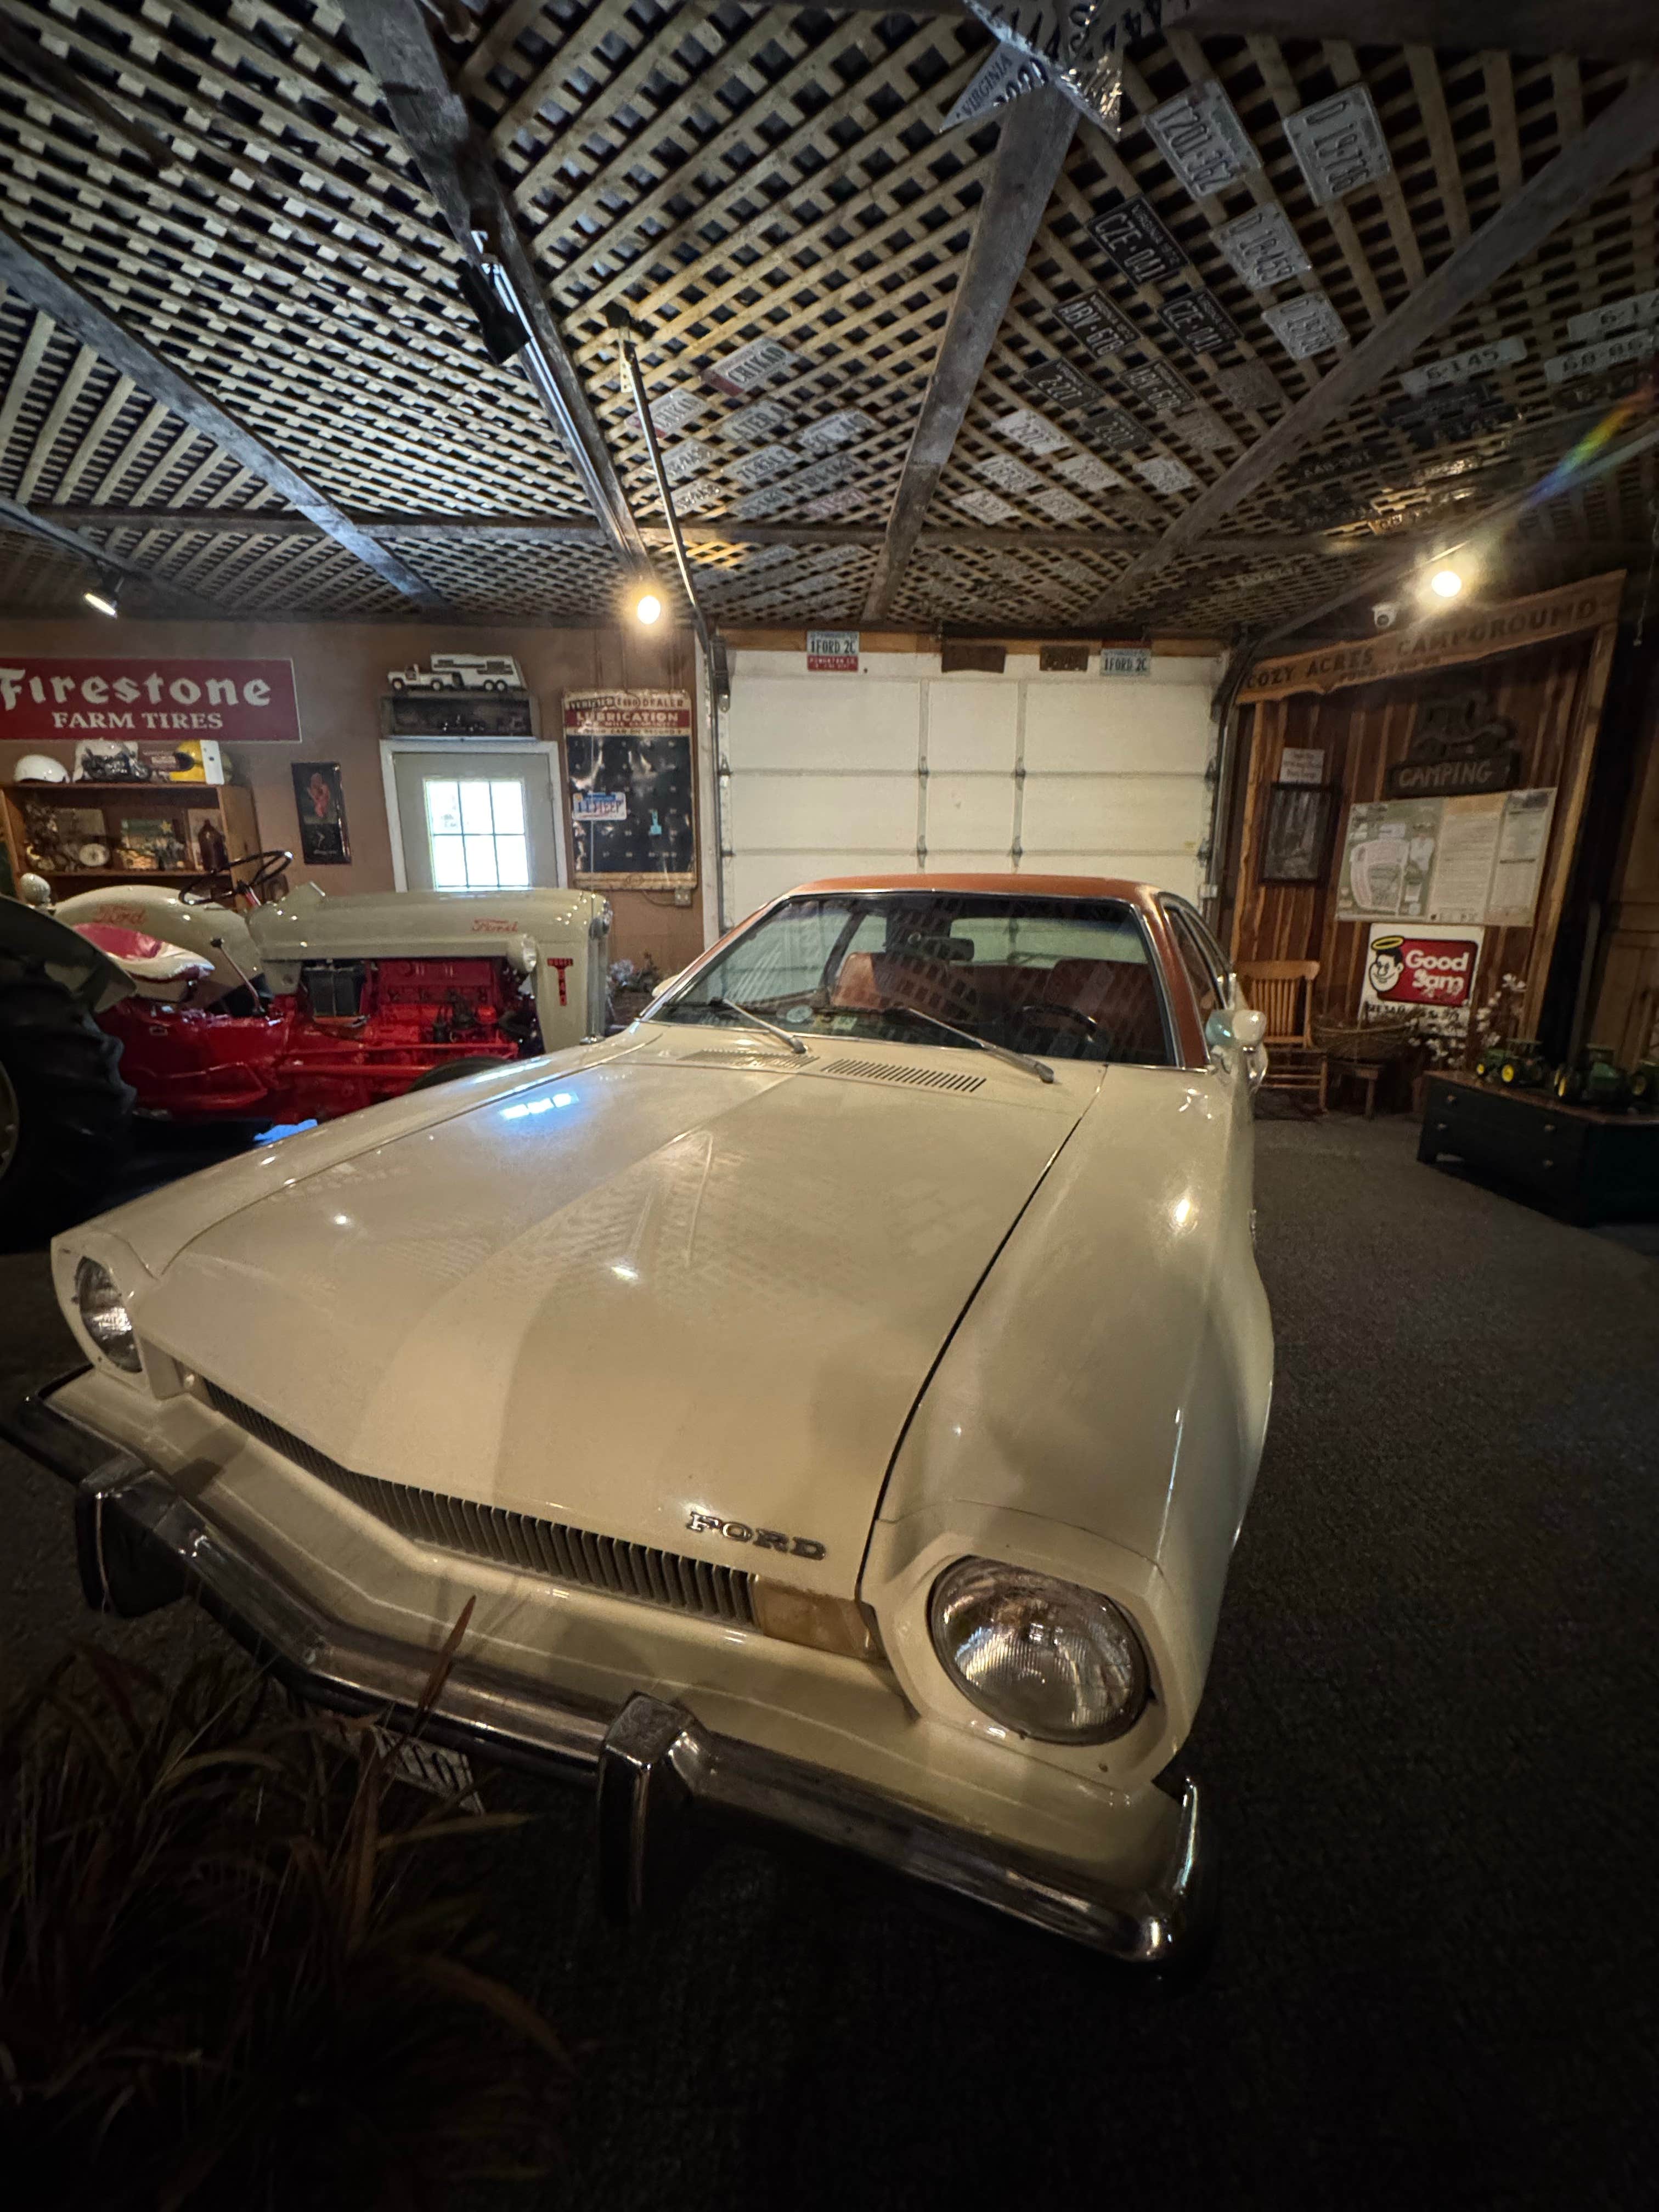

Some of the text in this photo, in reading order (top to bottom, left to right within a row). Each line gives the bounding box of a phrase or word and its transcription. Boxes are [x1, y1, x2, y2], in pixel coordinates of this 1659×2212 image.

[962, 55, 1012, 116] VIRGINIA
[811, 640, 840, 654] 1FORD
[1247, 667, 1294, 688] COZY
[1307, 648, 1373, 676] ACRES
[0, 668, 272, 709] Firestone
[642, 698, 683, 707] DEALER
[53, 712, 223, 729] FARM TIRES
[577, 712, 678, 721] LUBRICATION
[1398, 760, 1493, 787] CAMPING
[1406, 950, 1469, 971] Good
[1412, 969, 1464, 994] Sam
[686, 1511, 826, 1560] FORD
